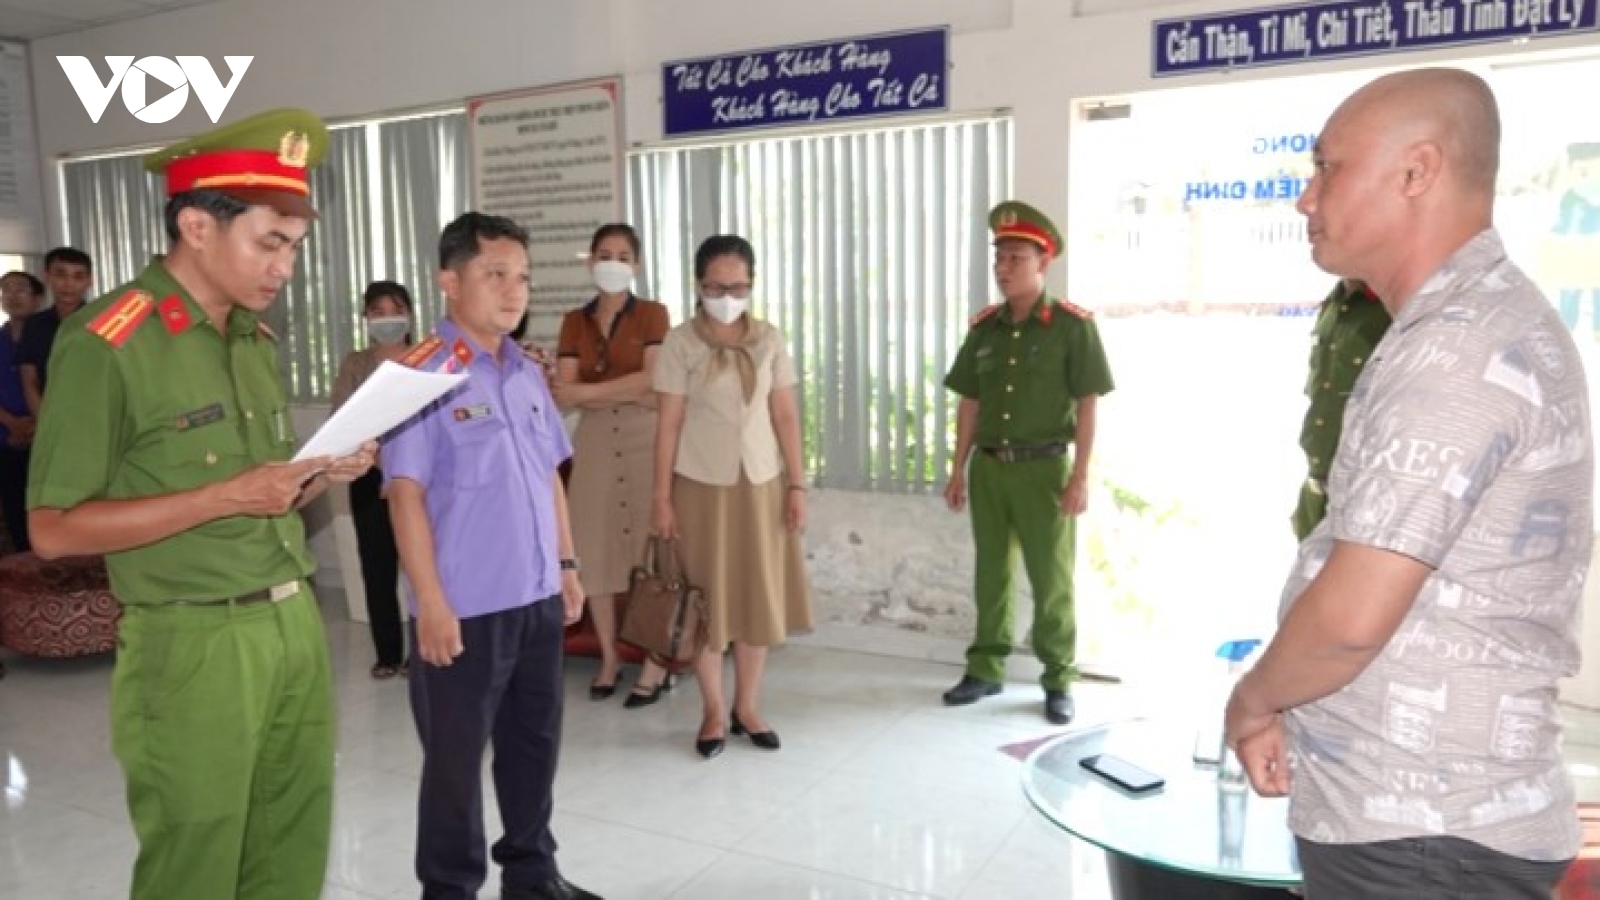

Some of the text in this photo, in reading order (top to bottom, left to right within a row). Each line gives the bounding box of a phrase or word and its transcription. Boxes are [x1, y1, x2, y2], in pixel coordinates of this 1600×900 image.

[1316, 8, 1349, 49] Chi
[672, 64, 703, 91] Tất
[736, 56, 770, 87] Cho
[775, 47, 832, 78] Khách
[838, 41, 891, 75] Hàng
[711, 94, 764, 123] Khách
[770, 88, 819, 120] Hàng
[825, 82, 860, 115] Cho
[867, 78, 903, 107] Tất
